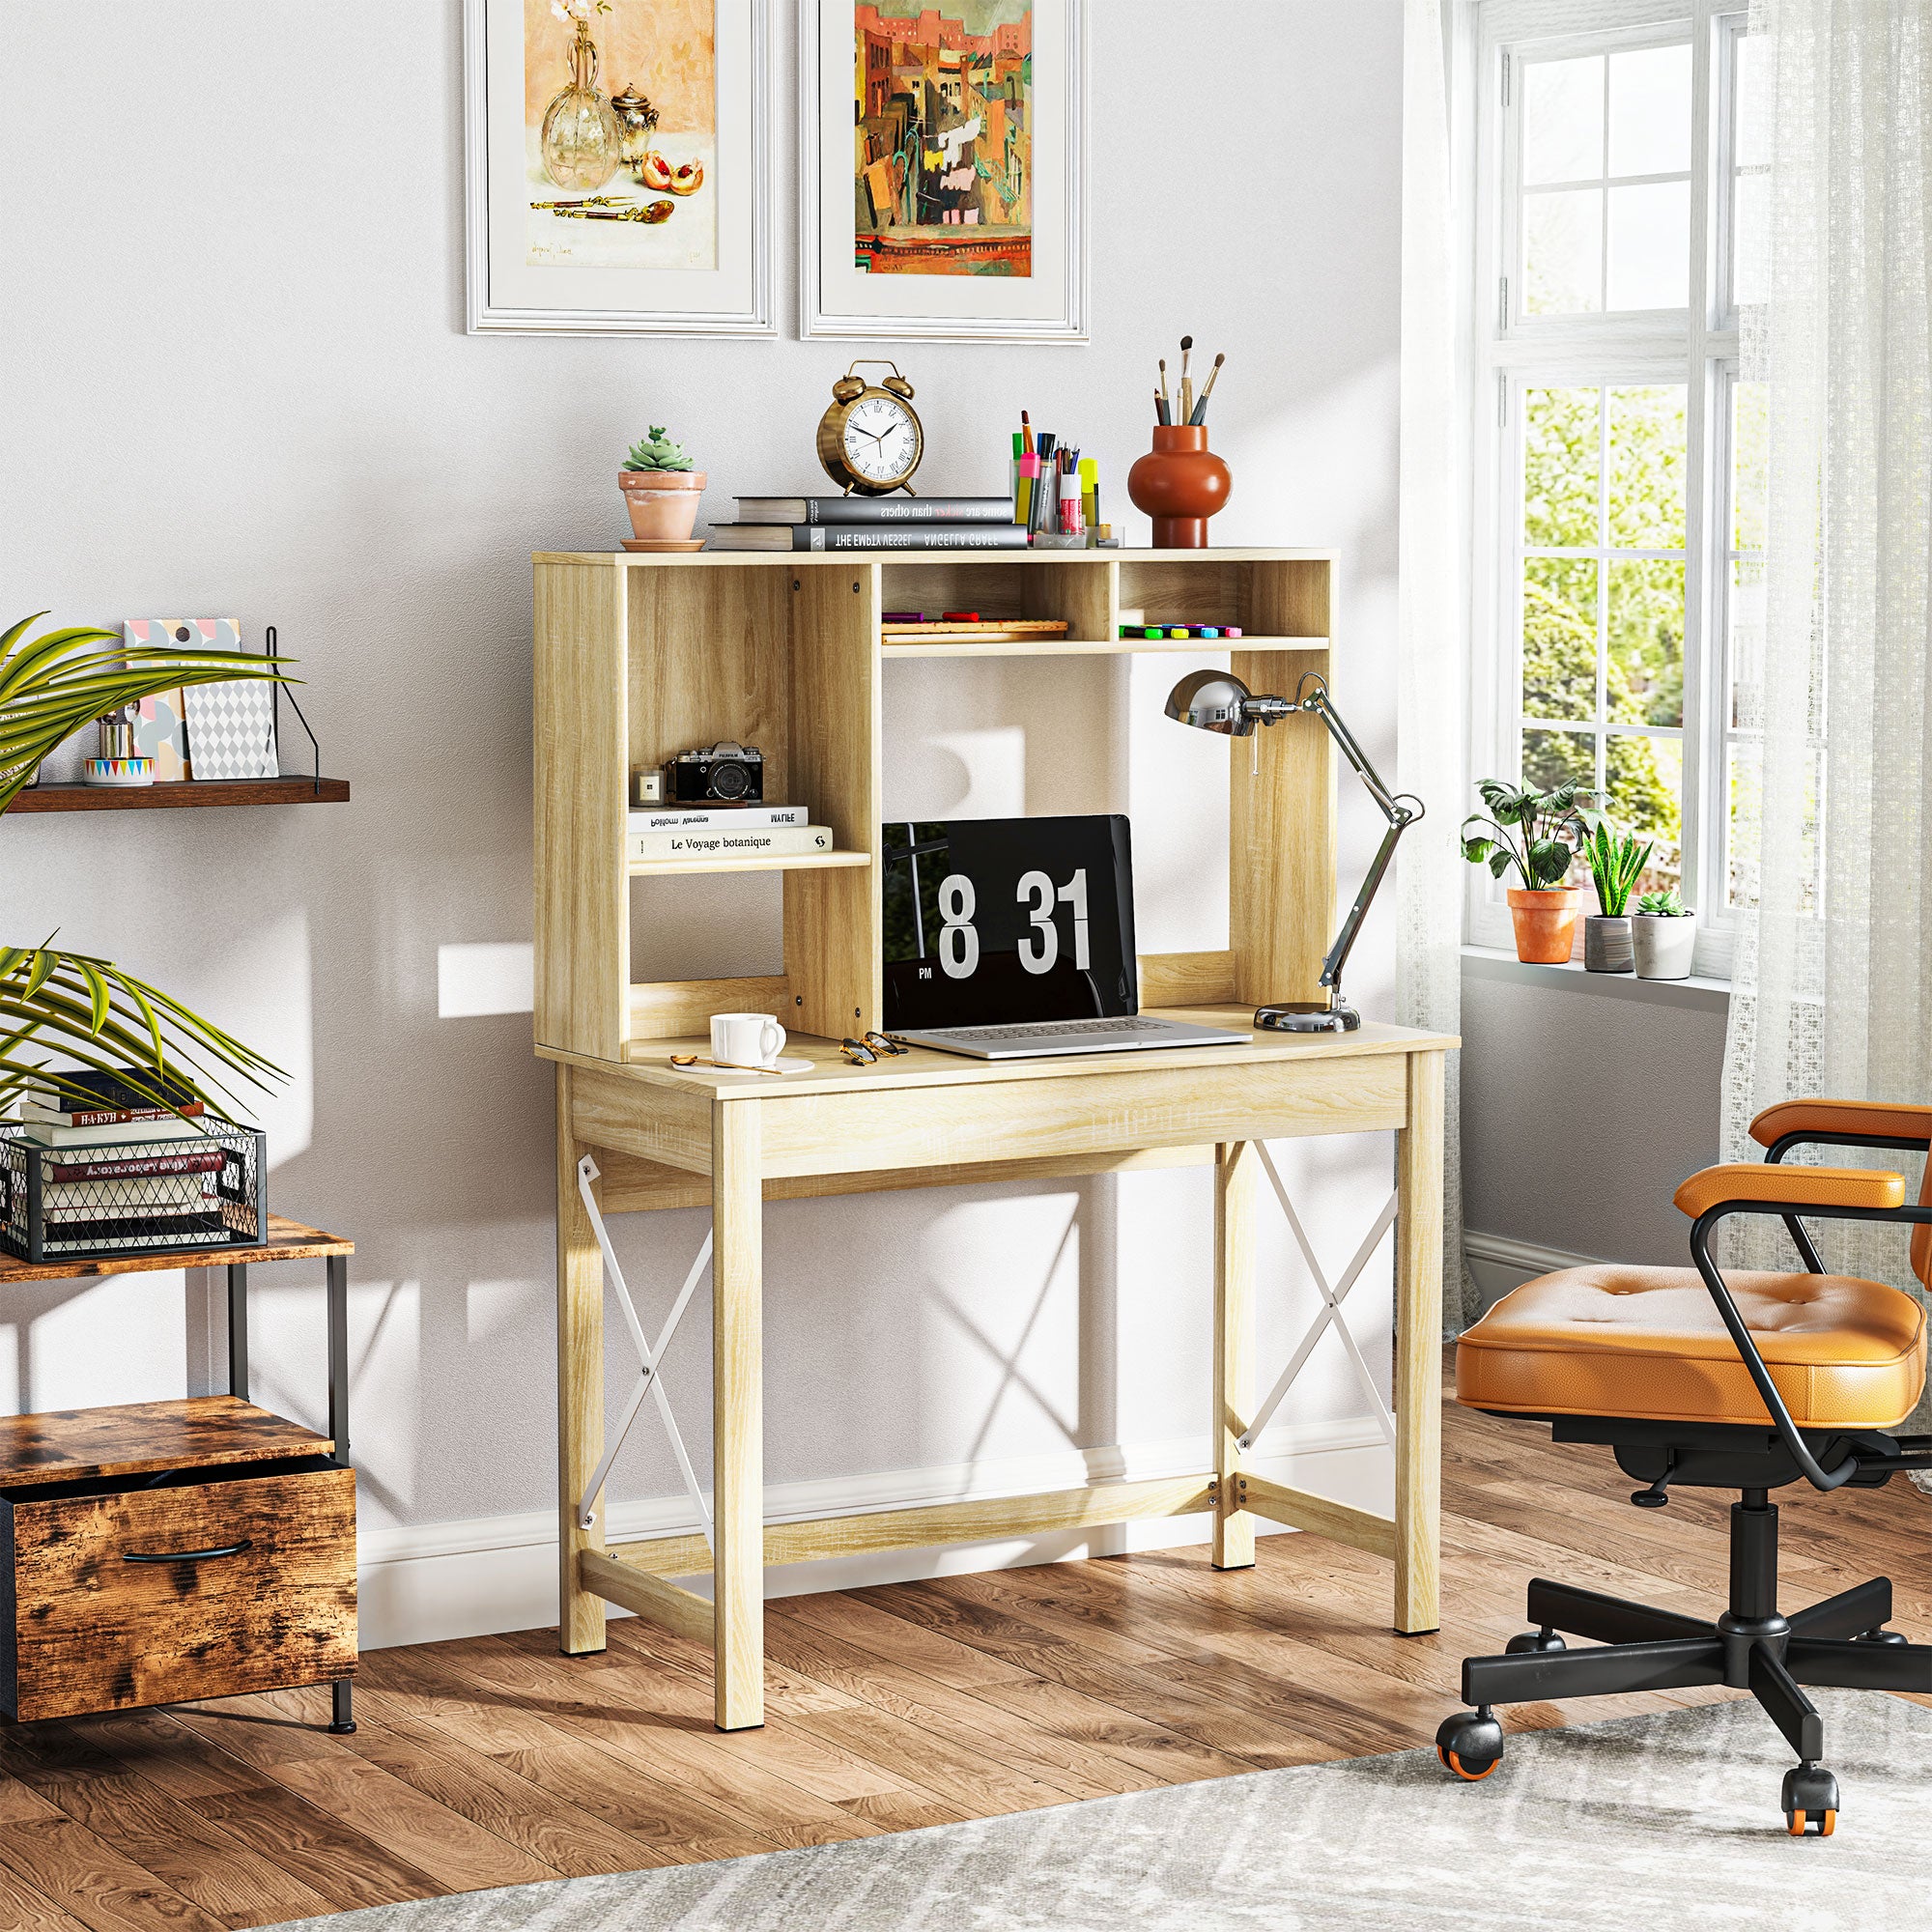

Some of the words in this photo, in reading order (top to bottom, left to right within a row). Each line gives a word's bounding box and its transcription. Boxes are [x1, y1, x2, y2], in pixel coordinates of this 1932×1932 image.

[671, 839, 683, 850] Le
[685, 838, 721, 852] Voyage
[723, 836, 772, 850] botanique
[938, 874, 980, 980] 8
[1016, 868, 1090, 975] 31
[919, 968, 932, 980] PM
